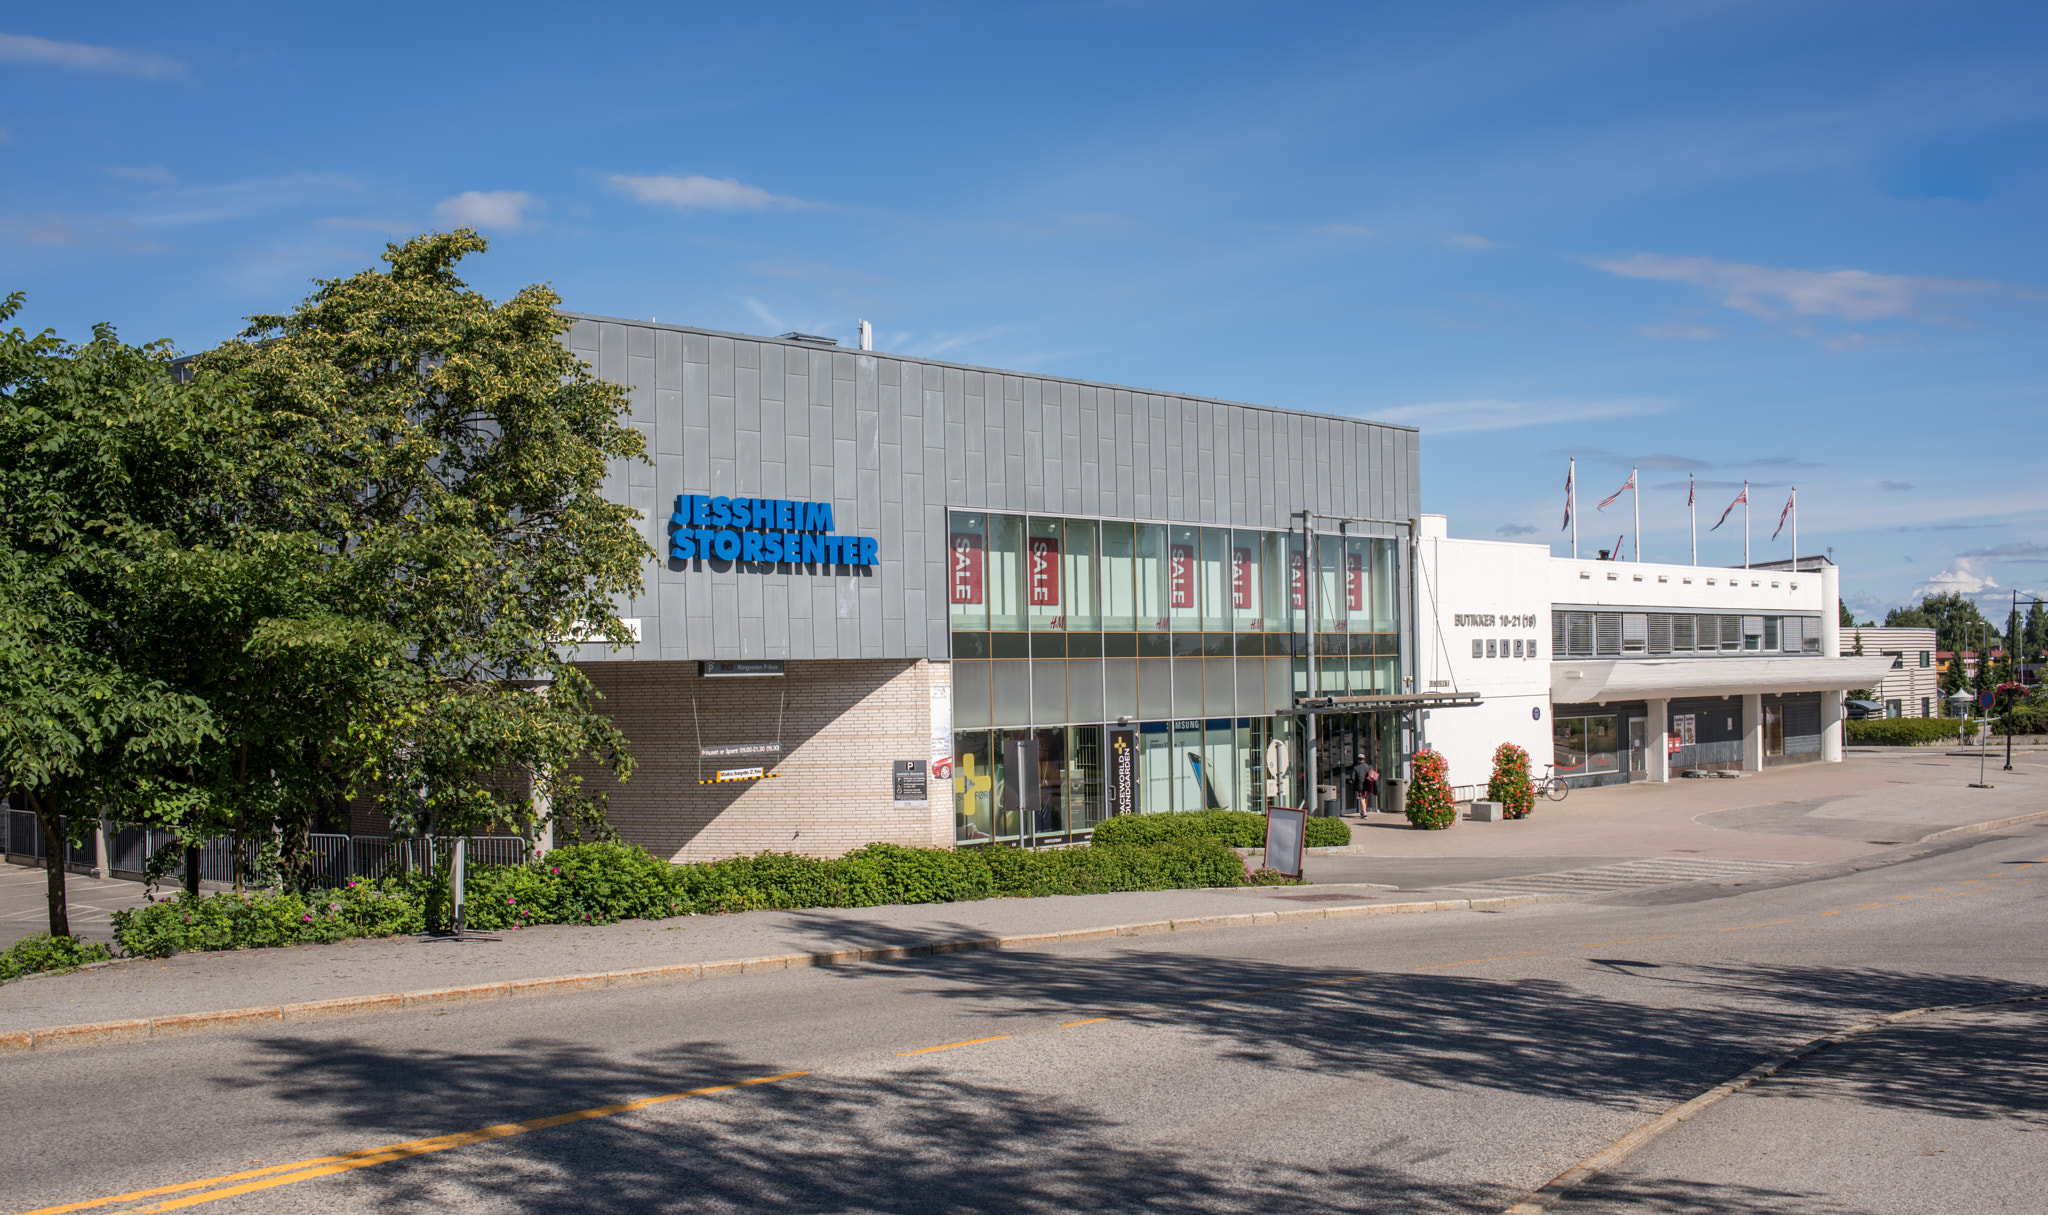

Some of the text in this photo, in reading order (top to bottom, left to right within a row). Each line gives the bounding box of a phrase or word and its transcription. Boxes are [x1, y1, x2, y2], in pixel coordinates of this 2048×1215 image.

[671, 494, 835, 532] JESSHEIM
[671, 528, 880, 566] STORSENTER
[955, 536, 971, 599] SALE
[1033, 541, 1048, 601] SALE
[1172, 548, 1185, 604] SALE
[1232, 551, 1243, 605] SALE
[1454, 613, 1496, 628] BUTIKKER
[1499, 614, 1521, 628] 10-21
[1166, 720, 1200, 730] SMSUNG
[907, 761, 914, 771] P
[1118, 755, 1126, 816] PACEWORLD
[1124, 748, 1132, 816] OUNDGARDEN
